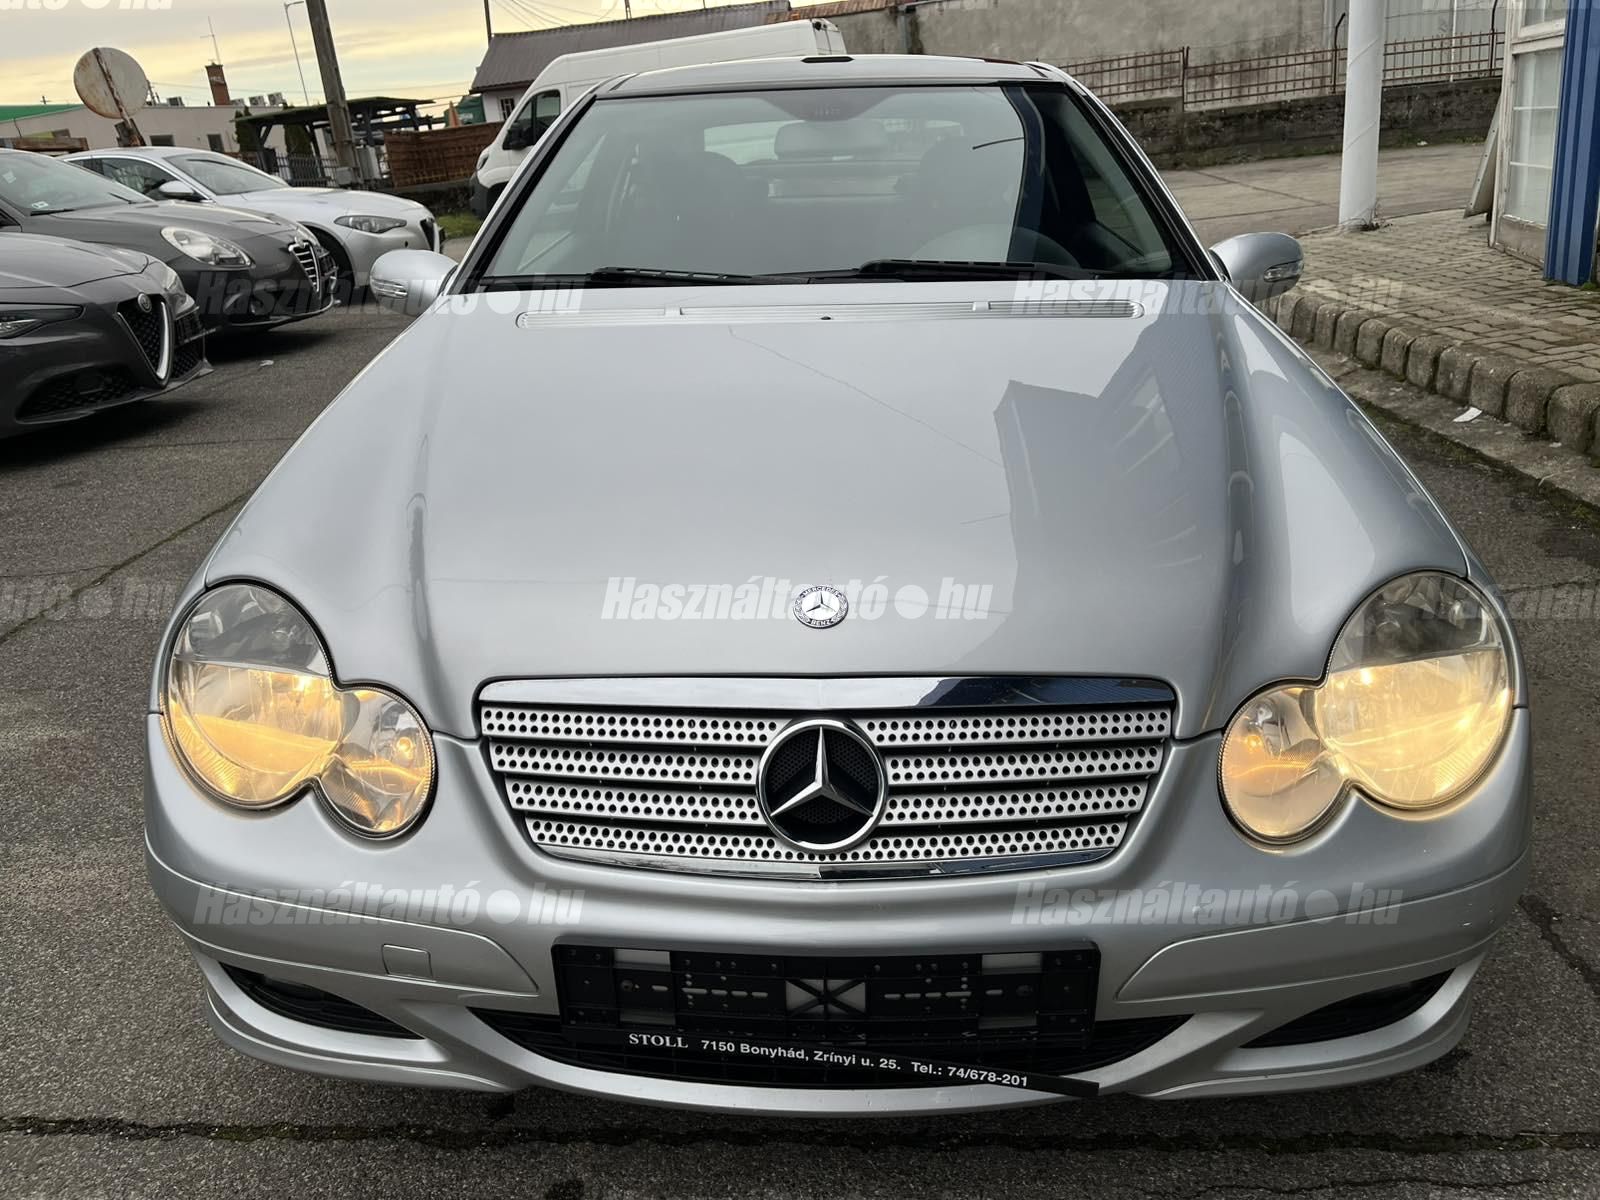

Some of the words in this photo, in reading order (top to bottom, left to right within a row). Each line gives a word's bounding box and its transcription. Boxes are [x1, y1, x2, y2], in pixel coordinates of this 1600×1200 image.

[628, 1033, 689, 1049] STOLL
[701, 1040, 736, 1053] 7150
[740, 1043, 809, 1062] Bonyhád,
[813, 1050, 856, 1067] Zrínyi
[861, 1057, 874, 1068] u.
[879, 1058, 901, 1070] 25.
[911, 1061, 943, 1076] Tel.:
[947, 1066, 1028, 1087] 74/678-201
